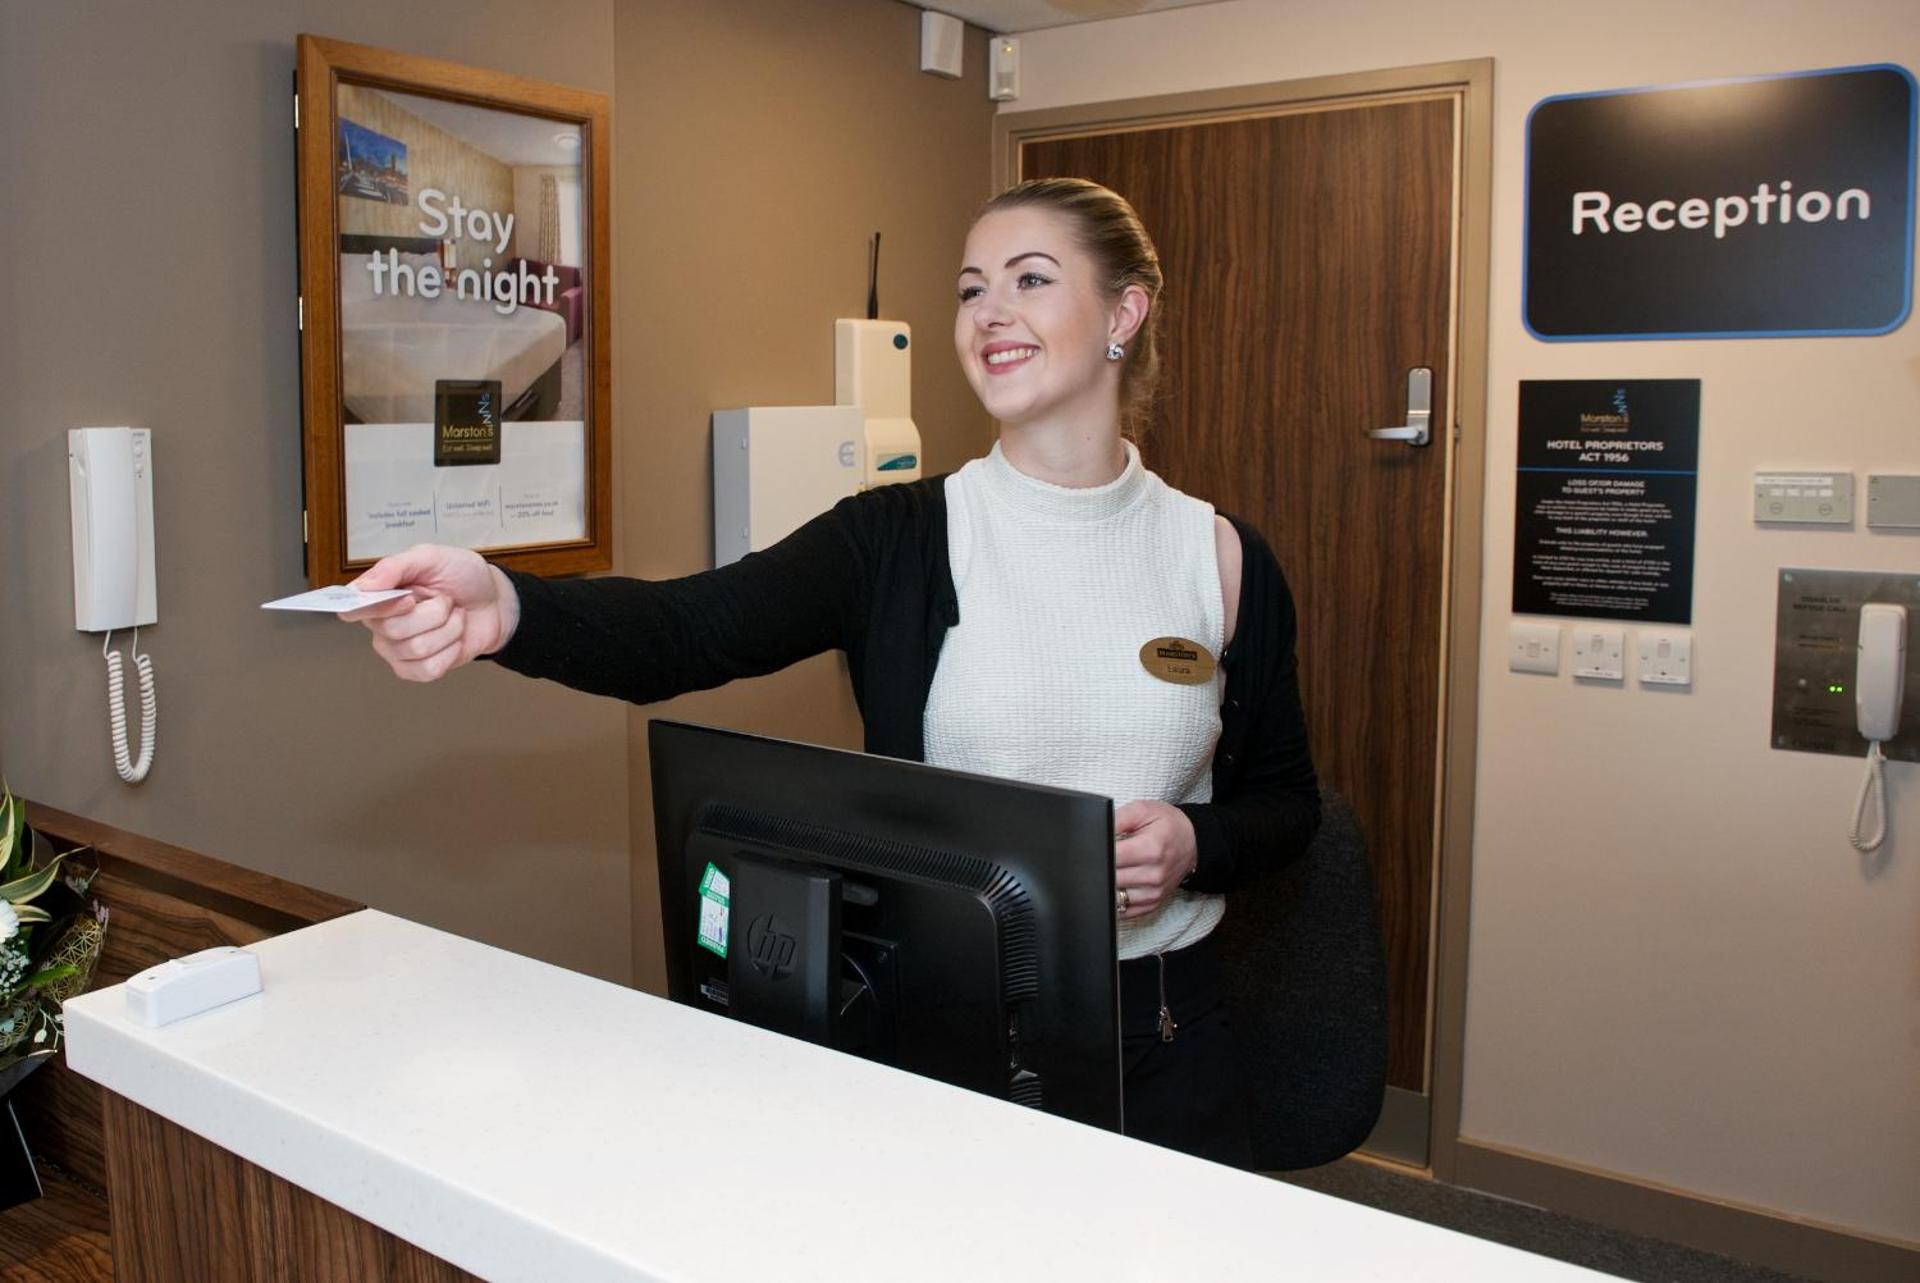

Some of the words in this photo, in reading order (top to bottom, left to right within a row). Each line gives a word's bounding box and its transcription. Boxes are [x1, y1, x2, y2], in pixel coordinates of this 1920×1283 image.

[418, 188, 514, 254] Stay
[1572, 180, 1870, 239] Reception
[366, 247, 441, 299] the
[457, 258, 559, 314] night
[1547, 440, 1582, 450] HOTEL
[1585, 440, 1664, 451] PROPRIETORS
[1579, 452, 1601, 462] ACT
[1603, 453, 1630, 463] 1956
